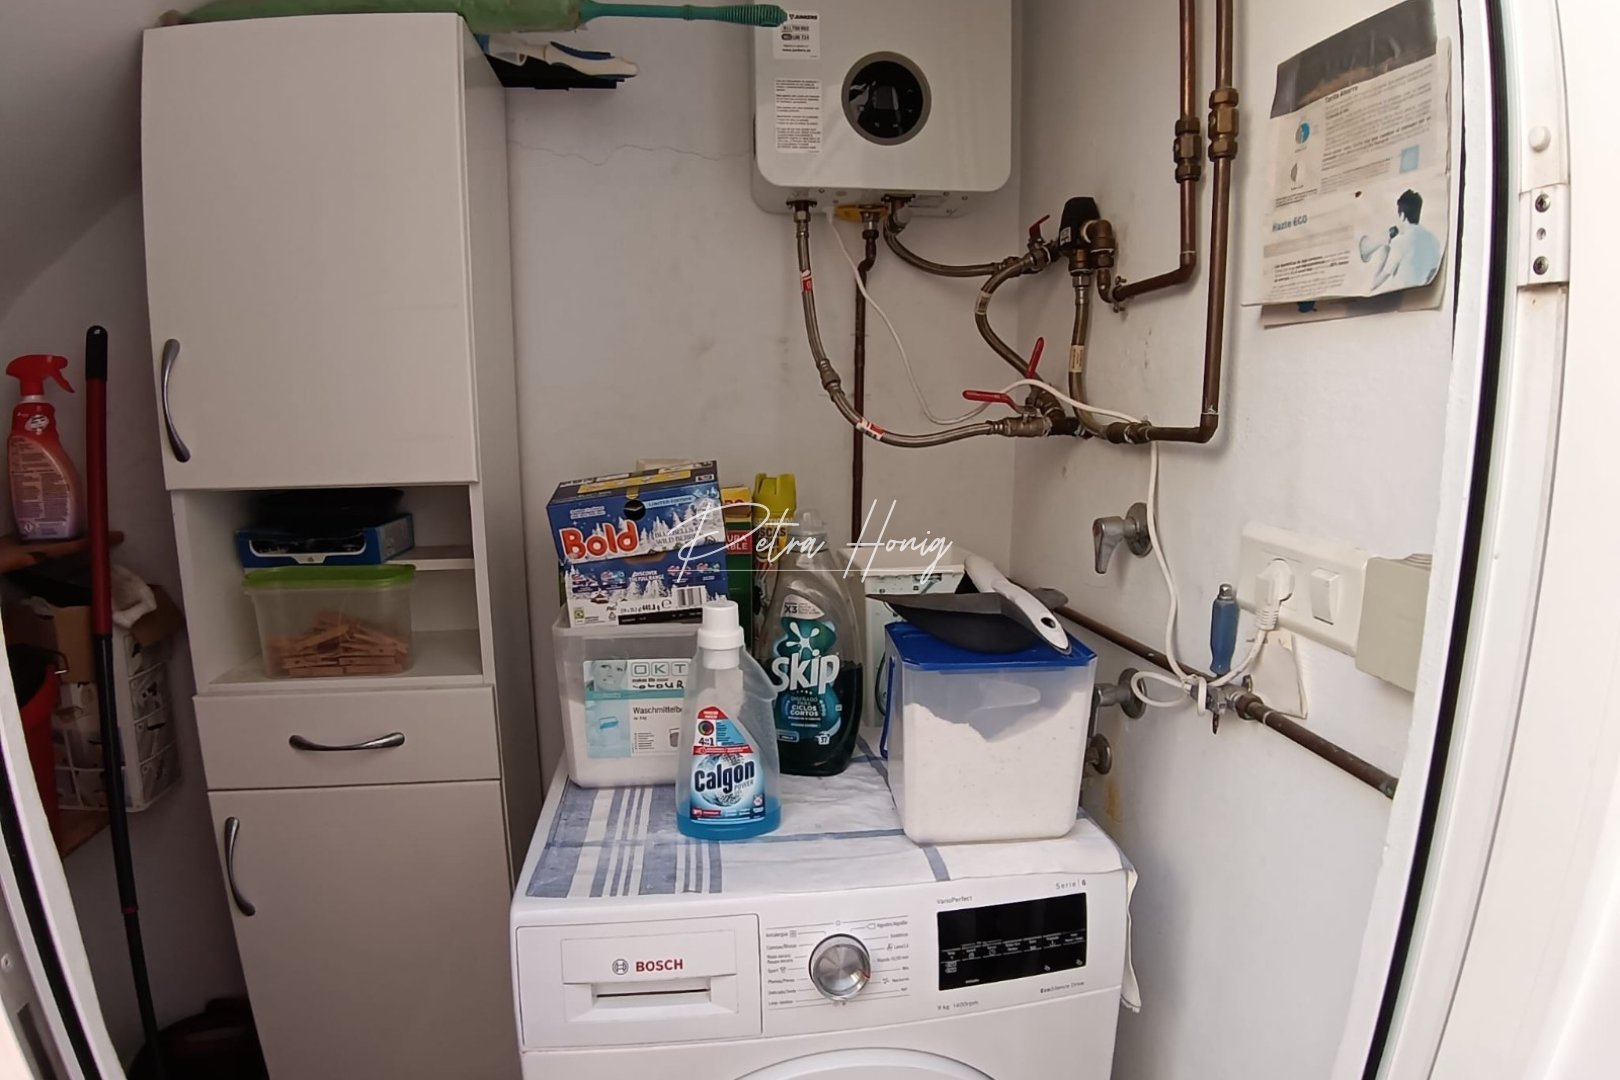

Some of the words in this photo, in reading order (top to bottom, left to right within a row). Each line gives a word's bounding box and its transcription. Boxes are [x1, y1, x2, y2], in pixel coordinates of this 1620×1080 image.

[1272, 218, 1292, 233] Hazte
[561, 519, 640, 561] Bold
[656, 536, 675, 546] WILD
[789, 710, 820, 718] CORTOS
[791, 704, 818, 712] CICLOS
[694, 760, 755, 795] Calgon
[1055, 881, 1077, 890] Serie
[635, 959, 684, 973] BOSCH
